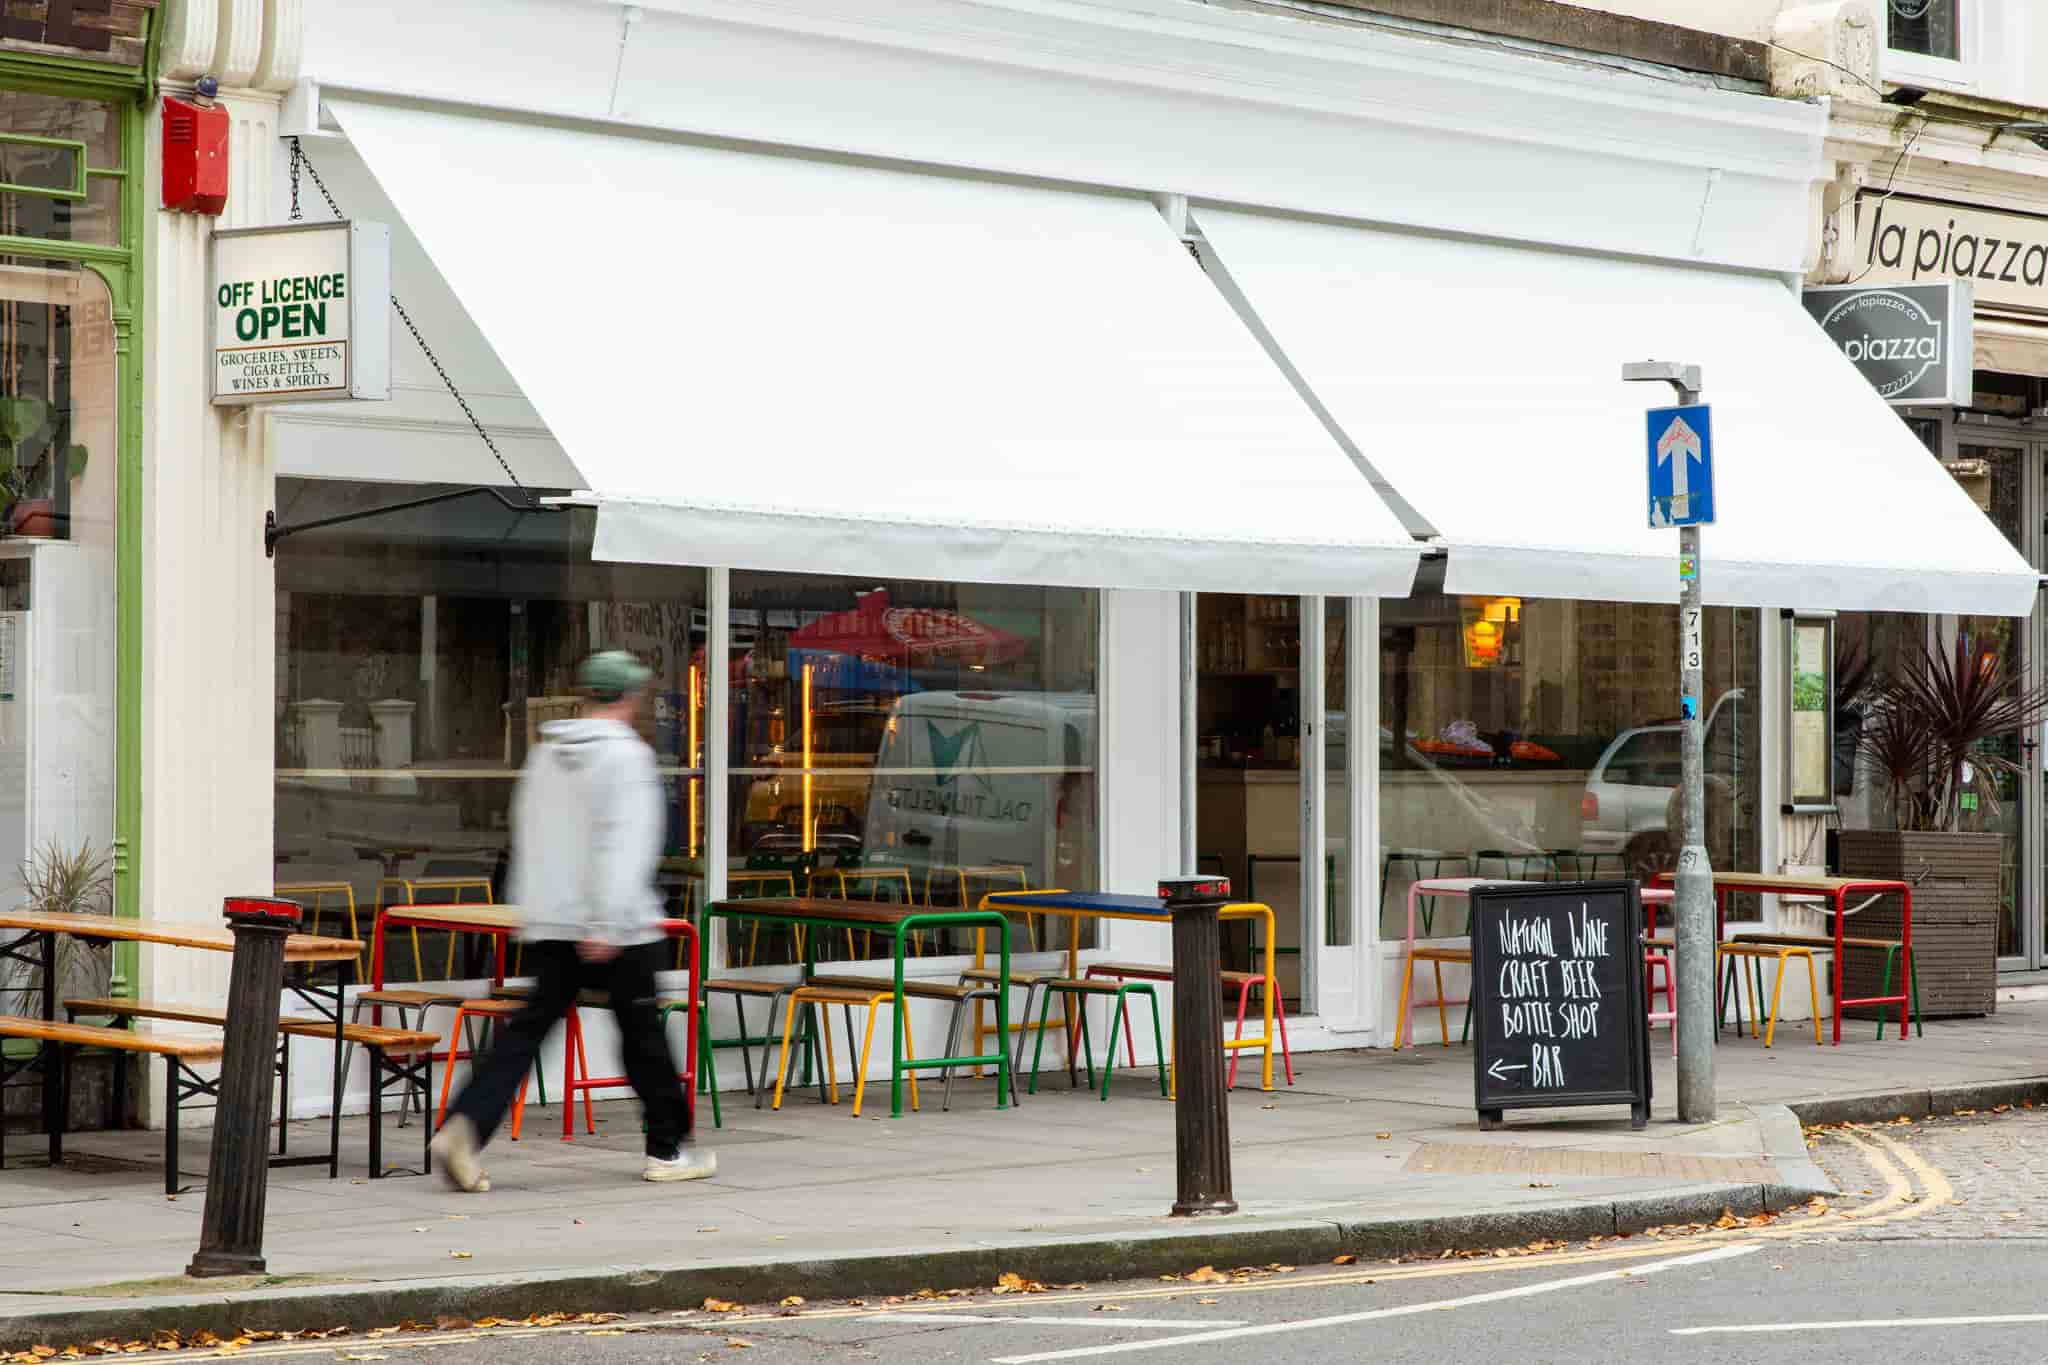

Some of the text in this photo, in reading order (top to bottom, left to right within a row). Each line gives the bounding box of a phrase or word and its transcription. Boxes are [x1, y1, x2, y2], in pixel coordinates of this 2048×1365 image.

[1867, 206, 2048, 288] la piazza
[218, 273, 345, 308] OFF LICENCE
[235, 301, 326, 342] OPEN
[220, 346, 341, 366] GROCERIES, SWEETS,
[1844, 333, 1936, 361] piazza
[231, 373, 330, 390] WINES & SPIRITS
[242, 361, 318, 377] CIGARETTES,
[1499, 901, 1611, 958] NATURAL WINE
[1499, 960, 1602, 998] CRAFT BEER
[1502, 1001, 1600, 1040] BOTTLE SHOP
[1532, 1042, 1565, 1088] BAR
